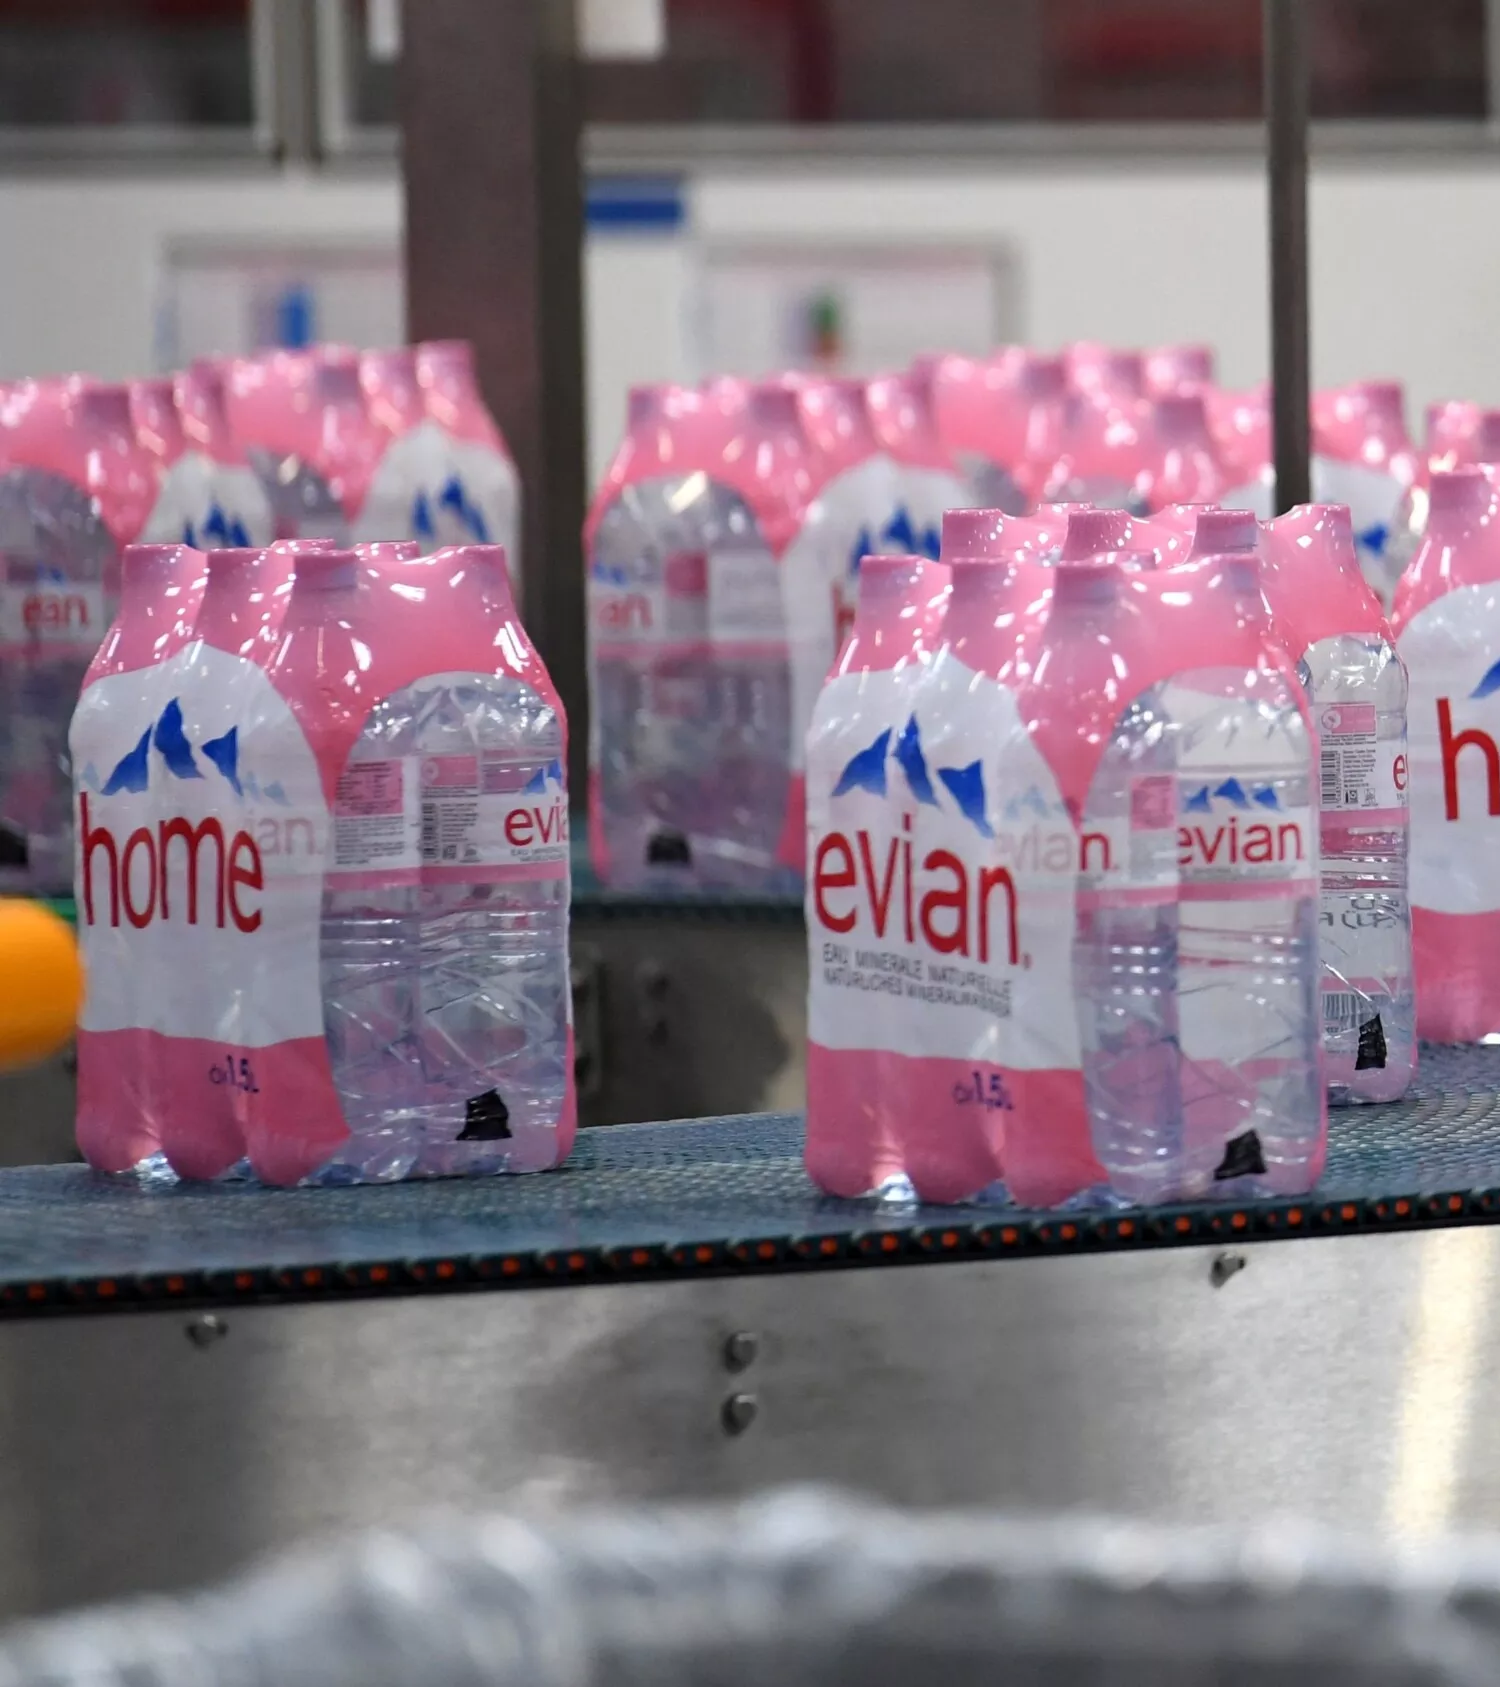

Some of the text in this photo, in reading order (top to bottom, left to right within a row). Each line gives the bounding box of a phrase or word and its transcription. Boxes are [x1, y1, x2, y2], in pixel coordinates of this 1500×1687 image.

[79, 793, 264, 934] home
[504, 796, 567, 848] evi
[1178, 816, 1304, 866] evian
[812, 813, 1021, 966] evian
